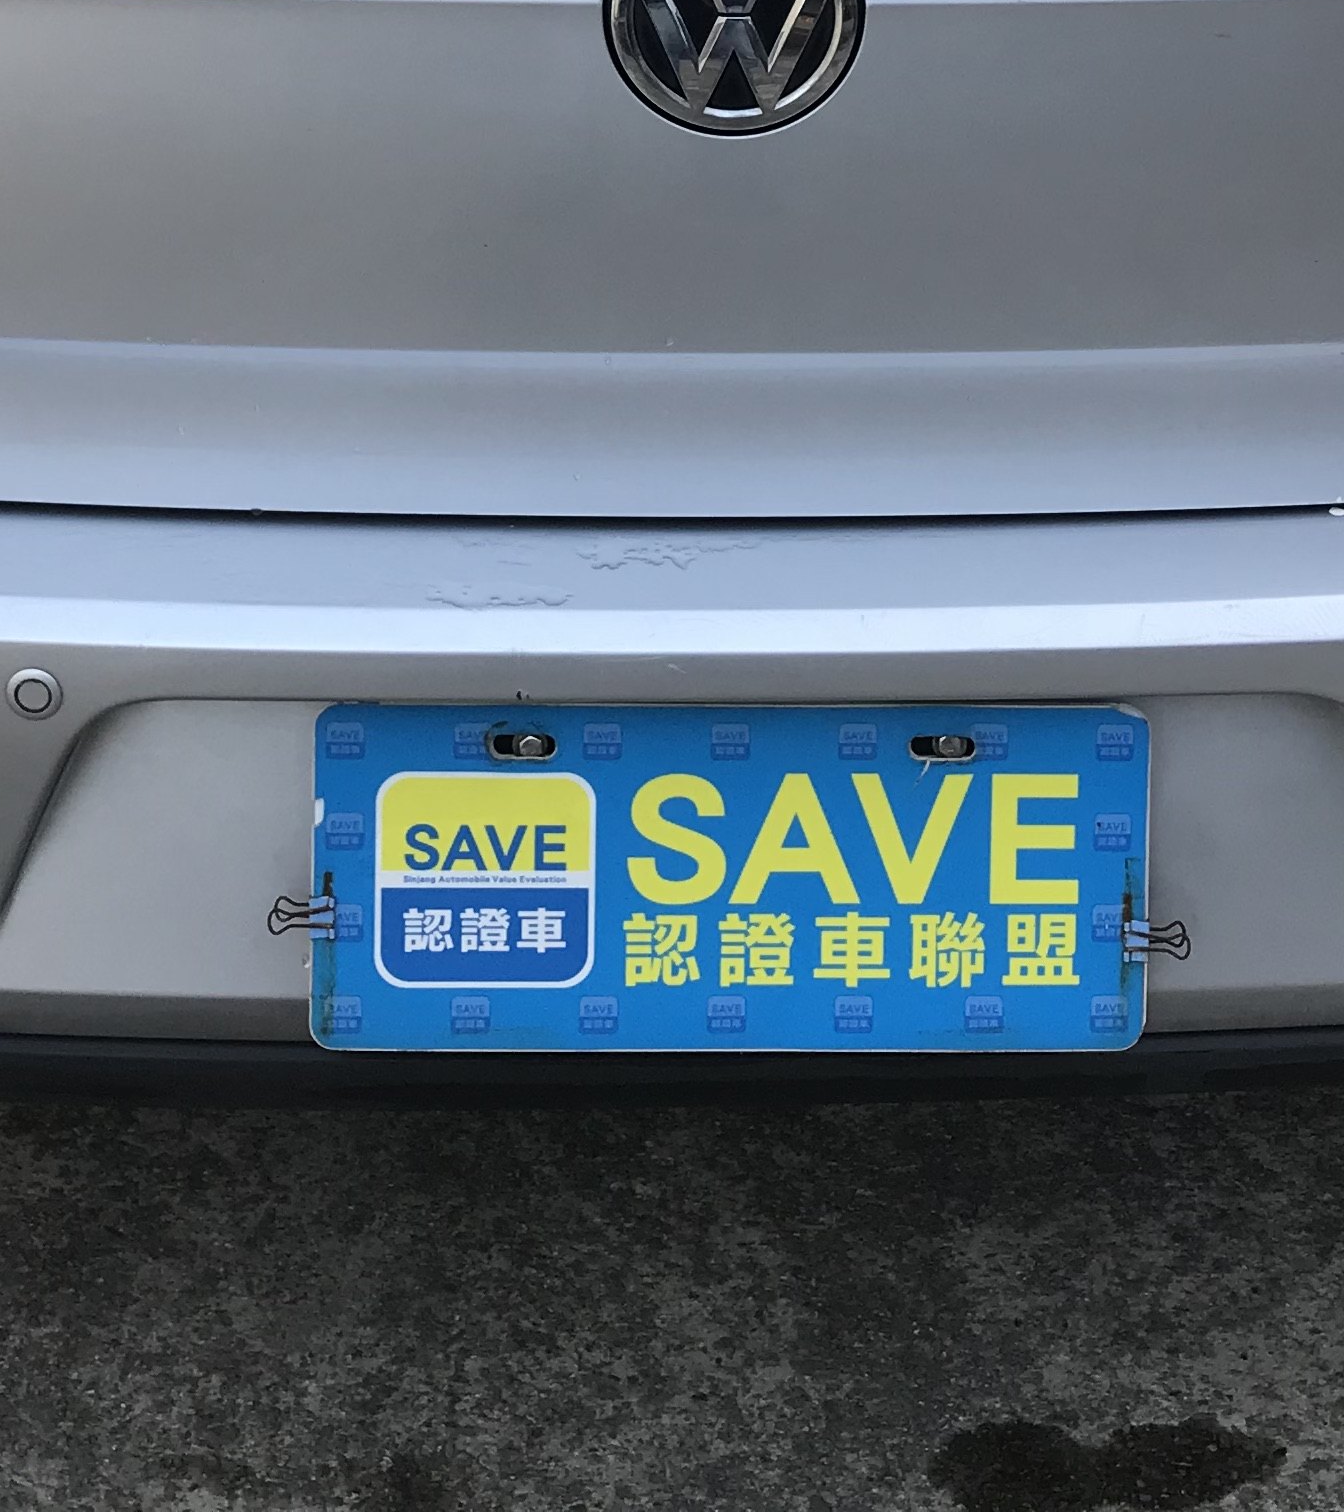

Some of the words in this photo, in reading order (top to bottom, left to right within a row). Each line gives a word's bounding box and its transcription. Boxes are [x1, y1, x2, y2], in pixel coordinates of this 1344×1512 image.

[403, 823, 567, 871] SAVE
[626, 772, 1080, 906] SAVE
[438, 875, 490, 883] Automobile
[492, 875, 517, 883] Value
[519, 875, 567, 883] Evaluation
[403, 907, 567, 953] 認證車
[623, 912, 1081, 988] 認證車聯盟
